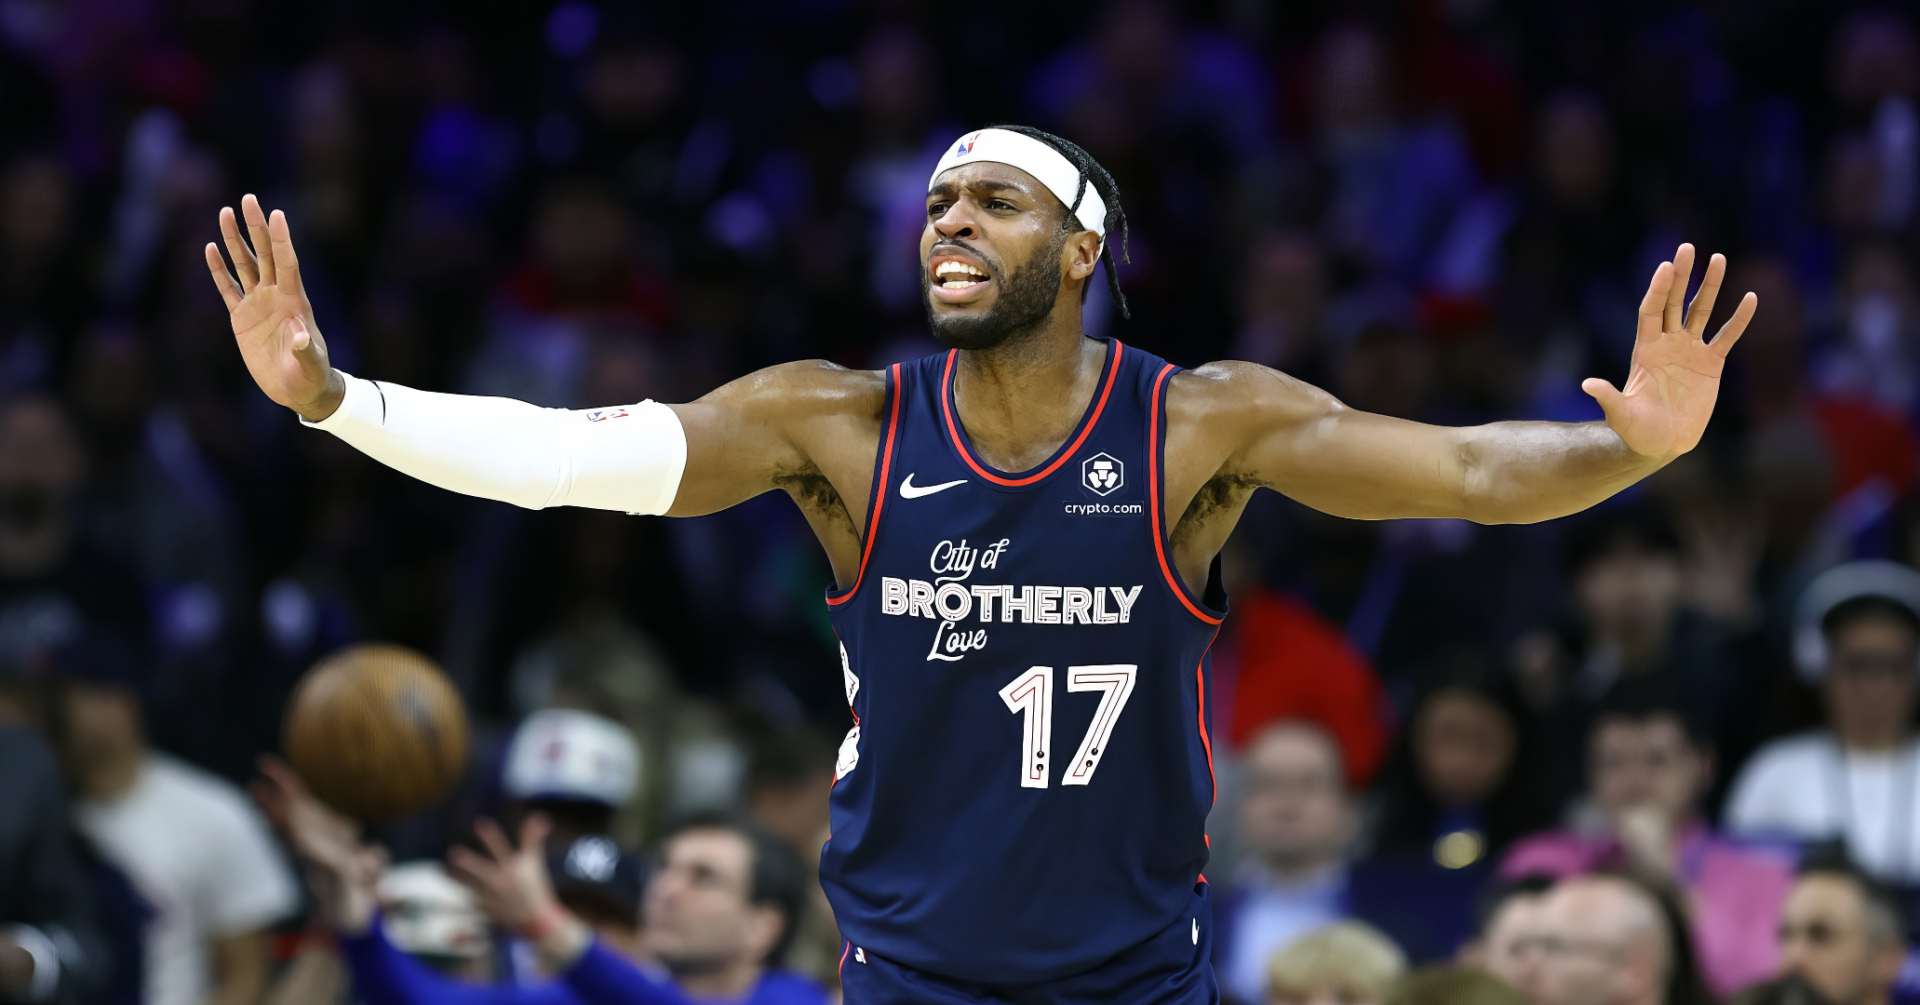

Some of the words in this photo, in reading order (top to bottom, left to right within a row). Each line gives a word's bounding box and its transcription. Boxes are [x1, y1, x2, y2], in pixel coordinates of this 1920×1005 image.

[1065, 502, 1142, 516] crypto.com
[930, 539, 979, 587] City
[980, 538, 1010, 570] of
[881, 576, 1144, 625] BROTHERLY
[926, 620, 988, 662] Love
[998, 664, 1138, 789] 17
